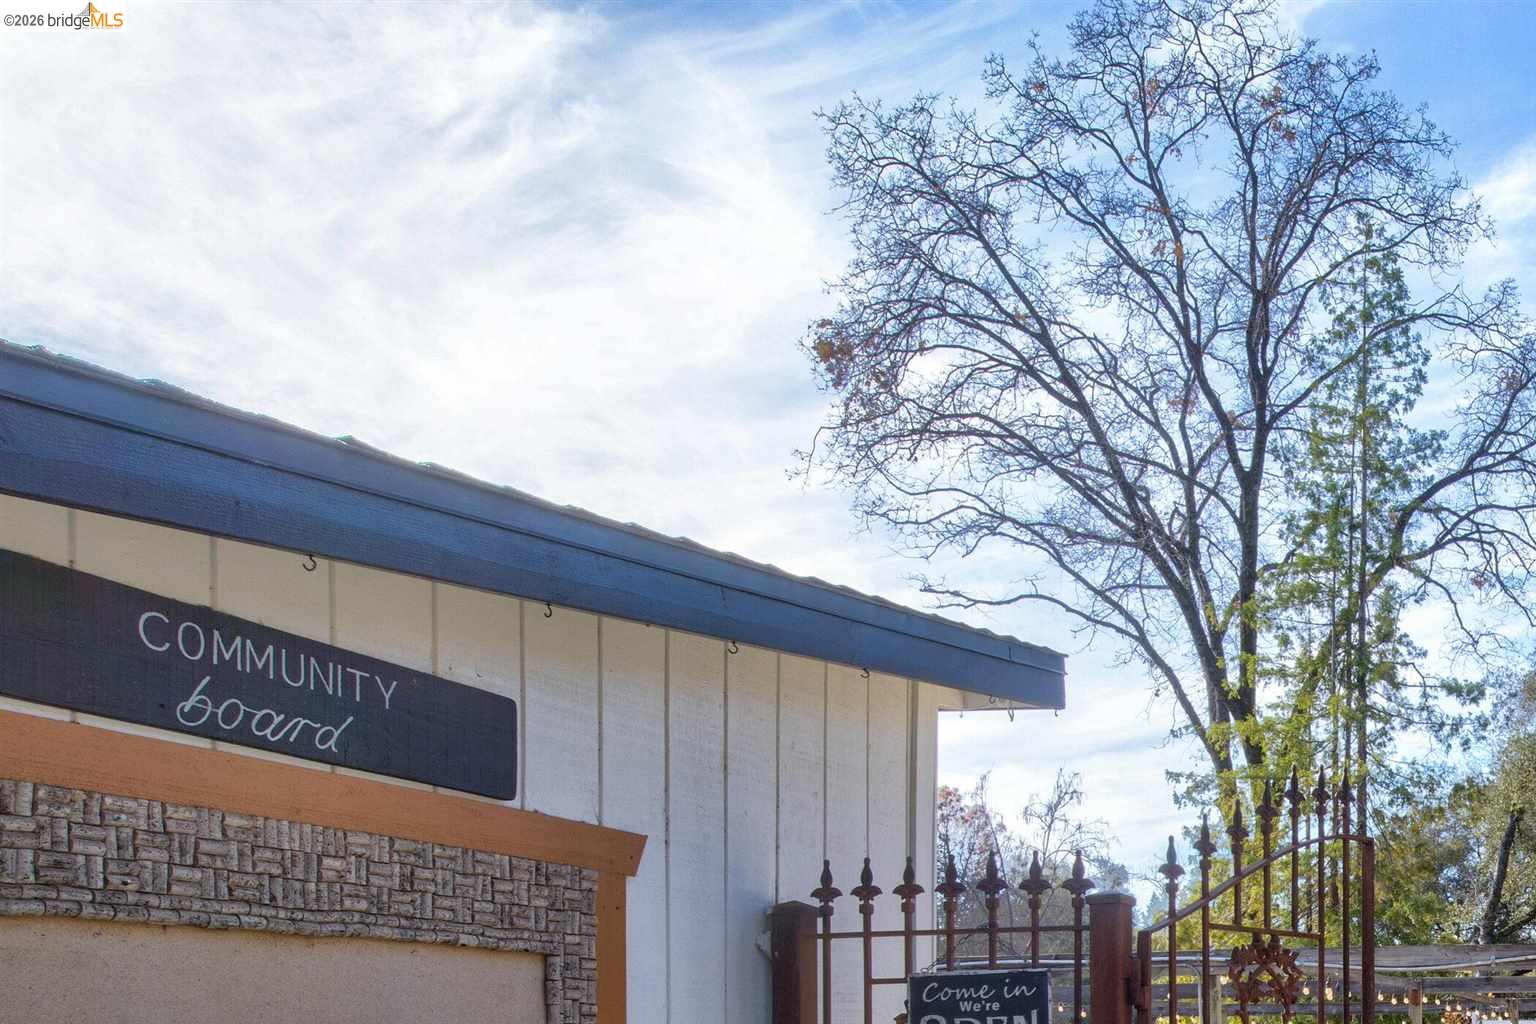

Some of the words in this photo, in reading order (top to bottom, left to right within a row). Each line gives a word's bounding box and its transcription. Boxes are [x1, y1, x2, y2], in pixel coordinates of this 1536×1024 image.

[139, 612, 397, 709] COMMUNITY
[176, 676, 354, 752] board
[923, 983, 995, 1002] Come
[1001, 978, 1037, 998] in
[959, 1000, 999, 1012] We're
